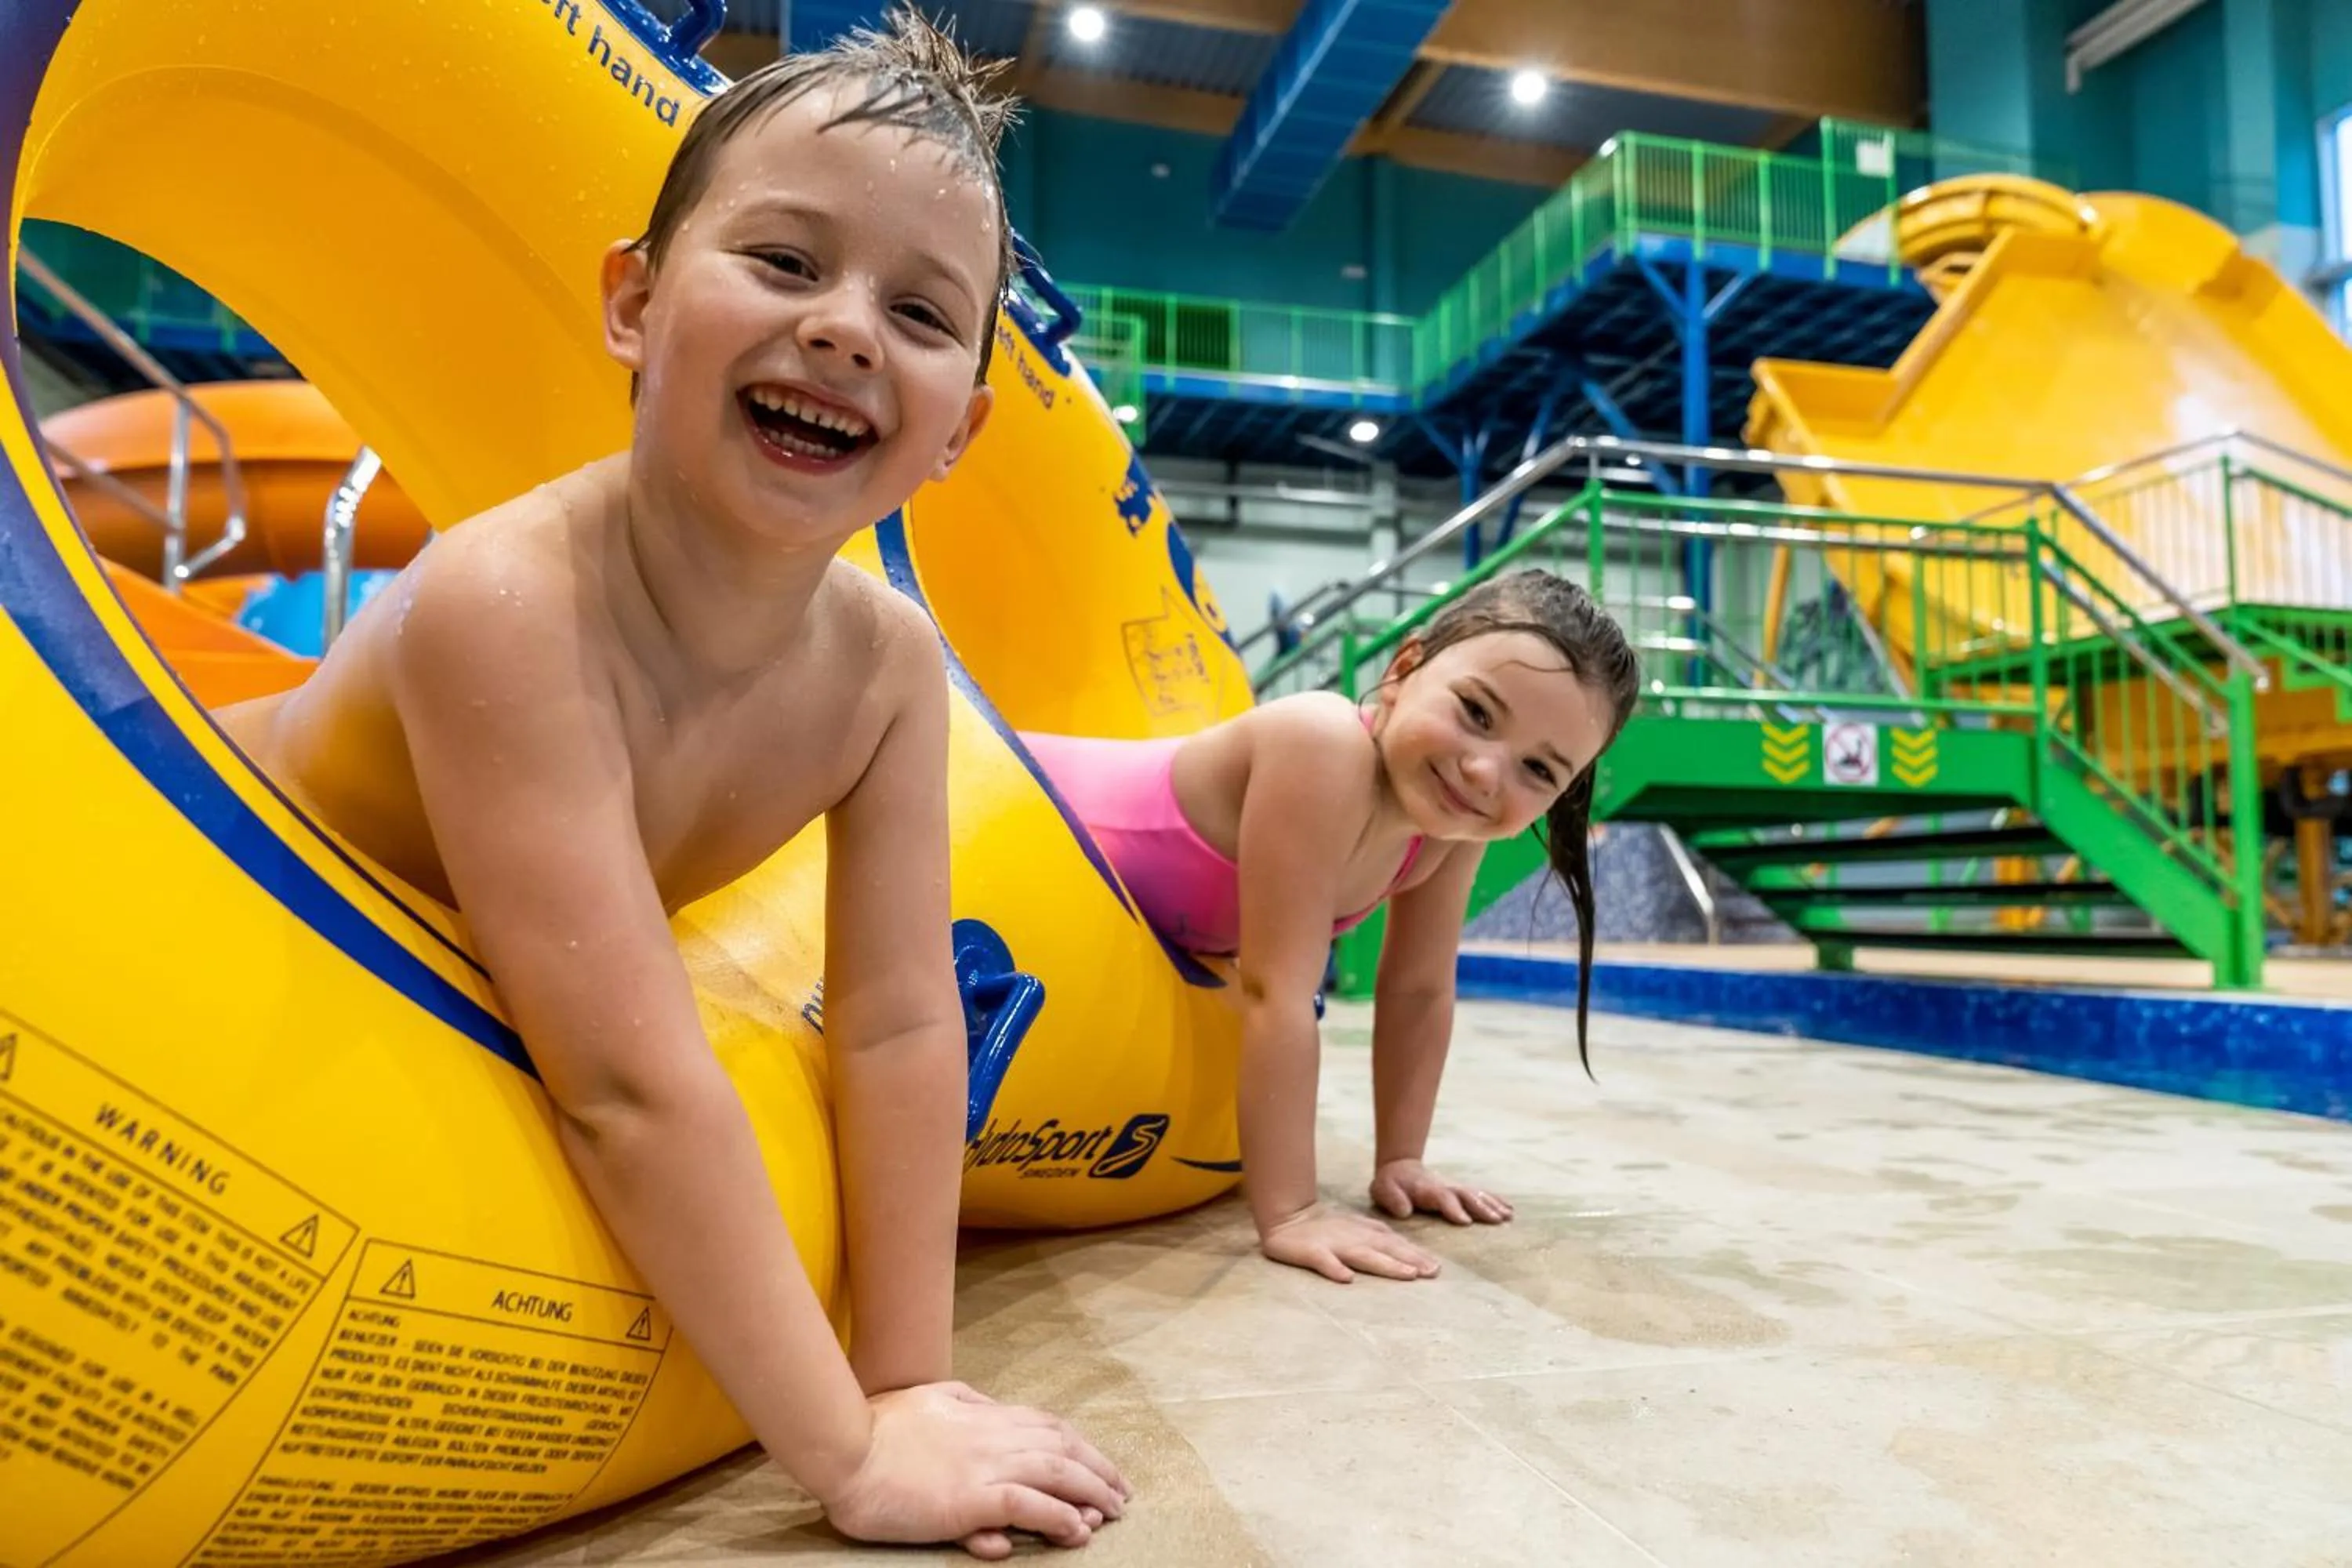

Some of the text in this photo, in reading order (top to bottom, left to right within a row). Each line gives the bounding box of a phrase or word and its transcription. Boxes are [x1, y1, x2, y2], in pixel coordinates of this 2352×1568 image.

[587, 24, 681, 128] hand
[1017, 350, 1055, 411] hand
[95, 1105, 230, 1196] WARNING
[491, 1290, 573, 1323] ACHTUNG
